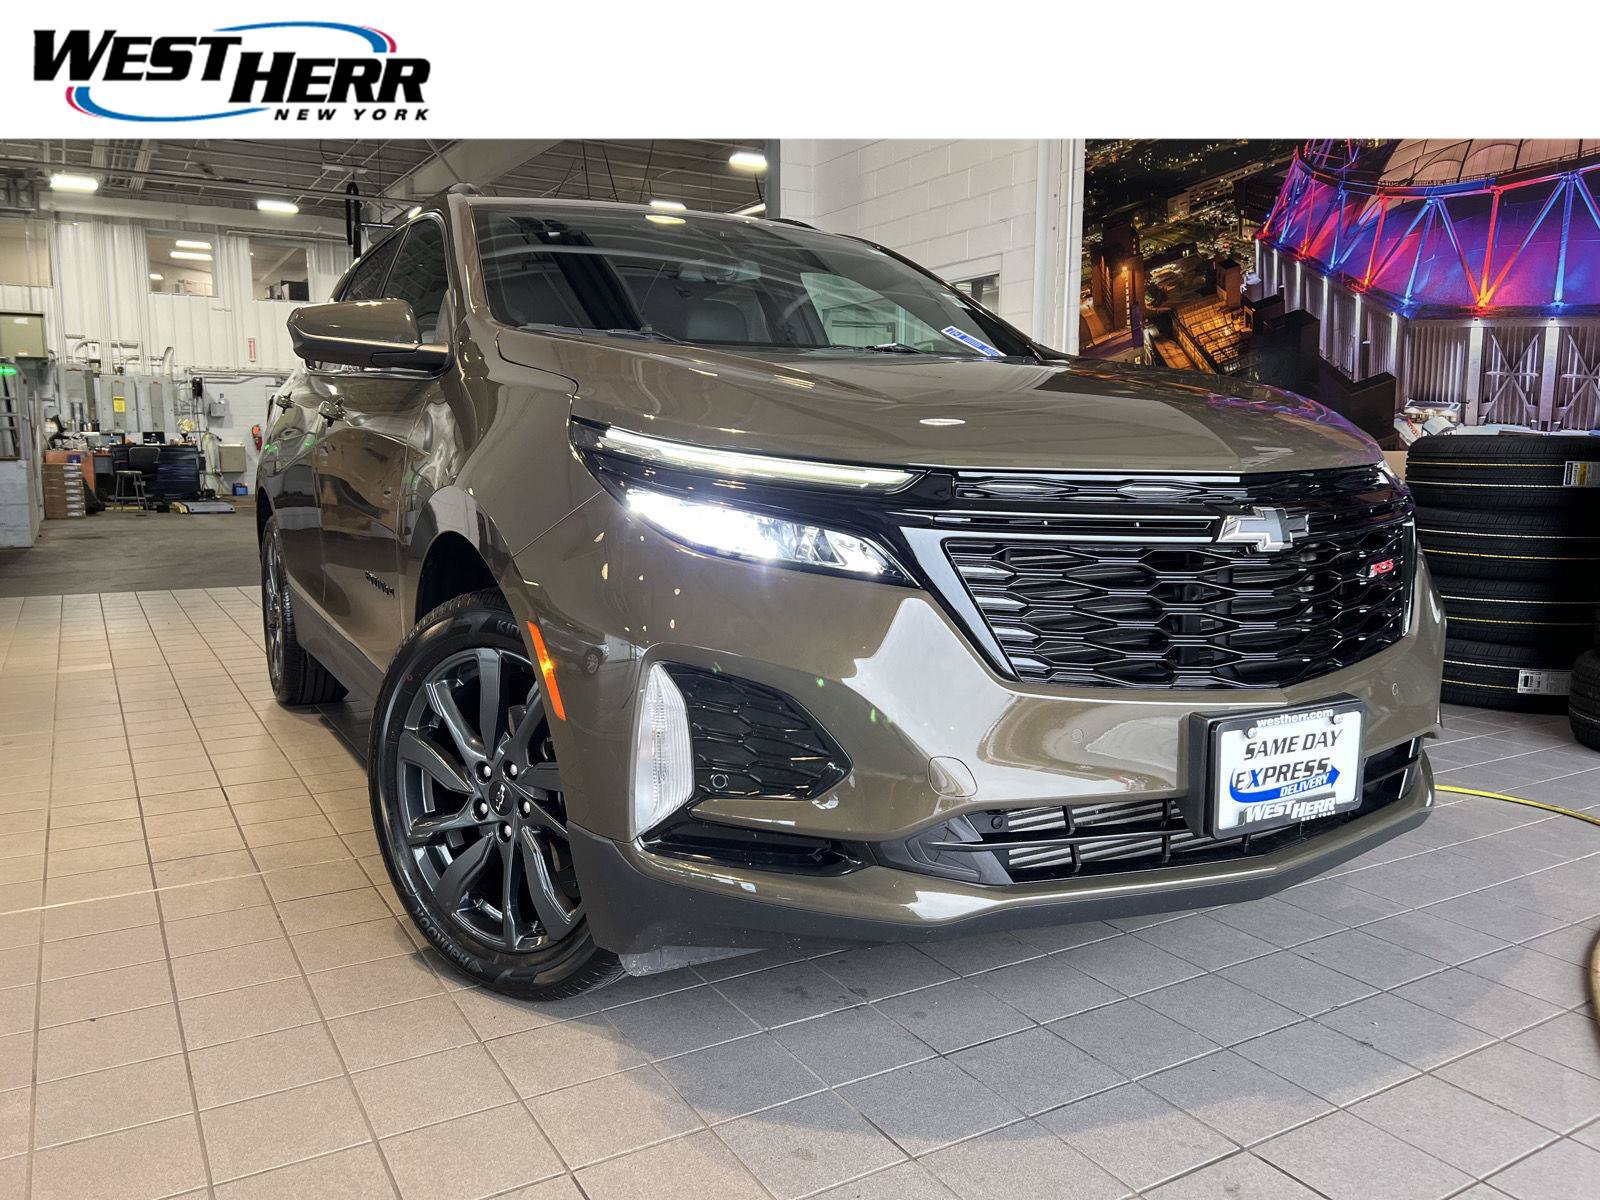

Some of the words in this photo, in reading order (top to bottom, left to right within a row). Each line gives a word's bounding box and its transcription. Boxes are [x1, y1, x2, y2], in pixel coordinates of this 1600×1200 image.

[1256, 709, 1334, 728] westherr.com
[1244, 735, 1300, 760] SAME
[1302, 729, 1343, 751] DAY
[1235, 757, 1330, 790] EXPRESS
[1280, 773, 1330, 799] DELIVERY
[1245, 799, 1297, 823] WEST
[1290, 797, 1336, 819] HERR
